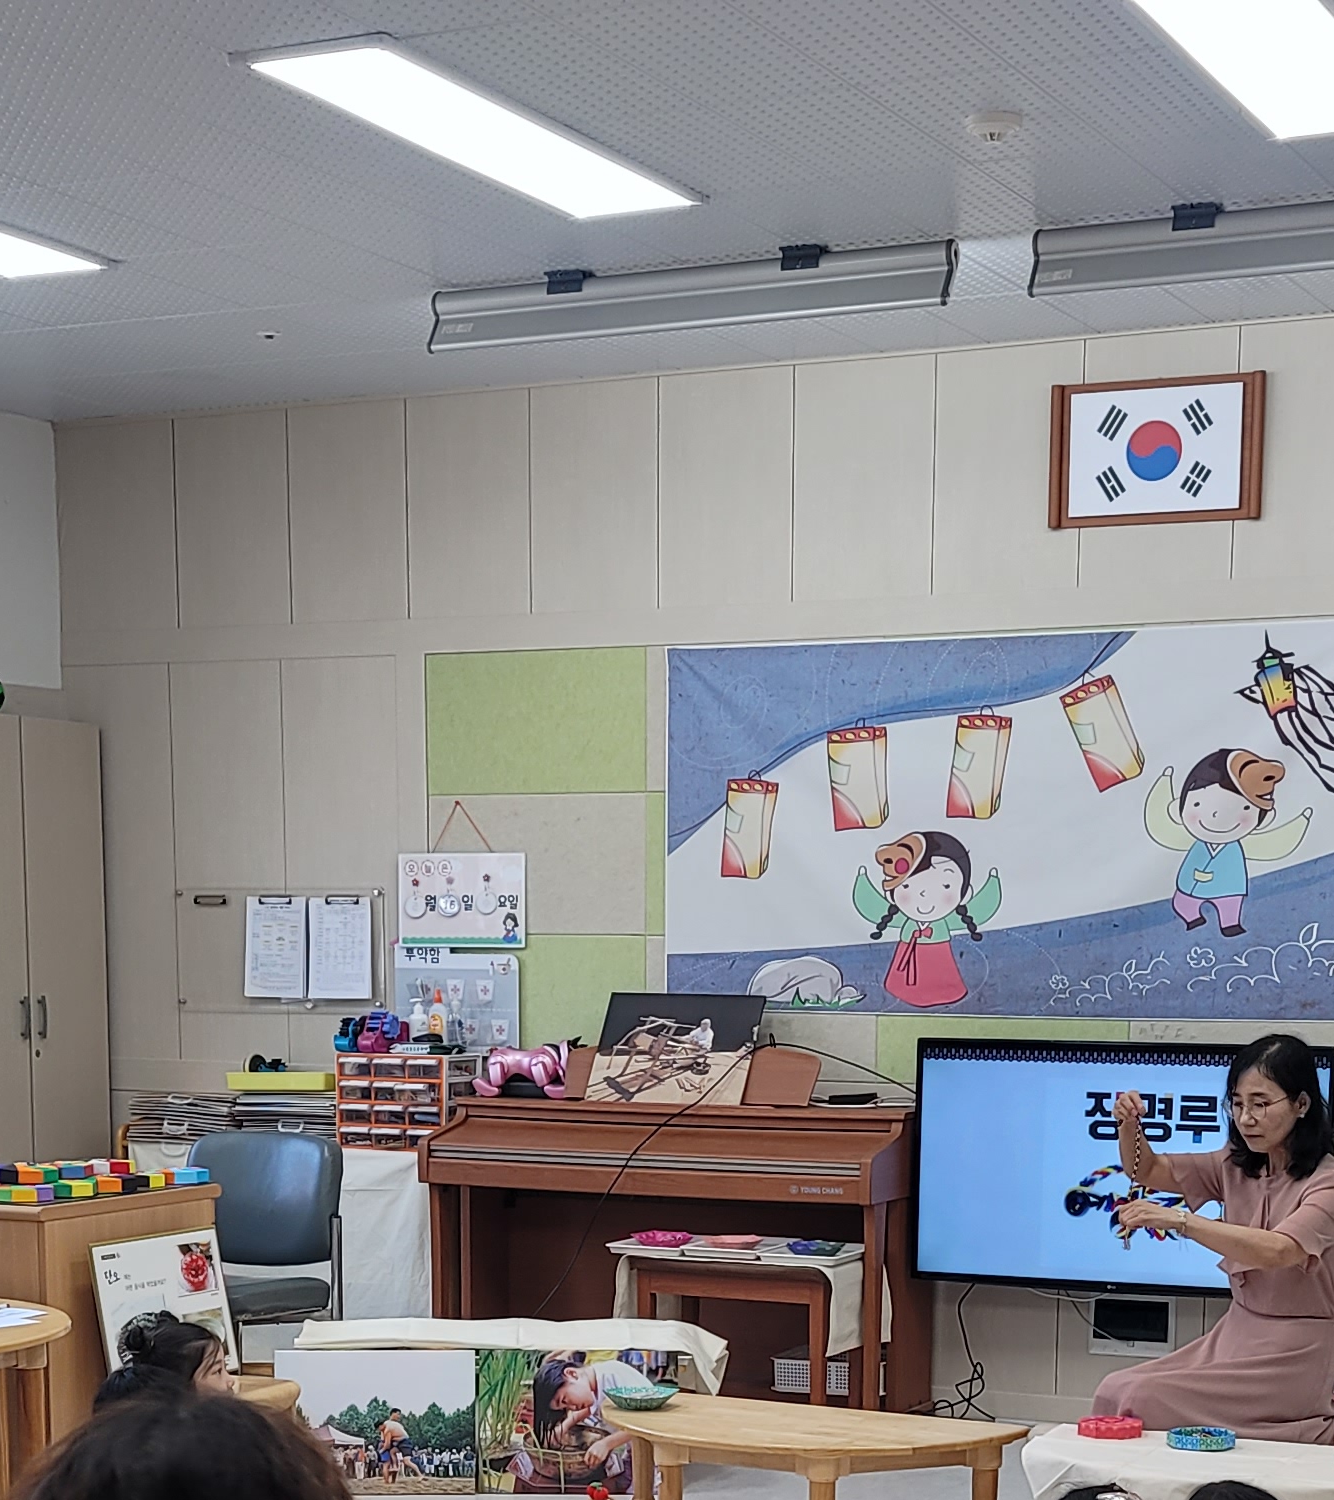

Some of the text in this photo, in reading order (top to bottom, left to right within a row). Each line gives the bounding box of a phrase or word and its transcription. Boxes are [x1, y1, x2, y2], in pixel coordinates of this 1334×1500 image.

[406, 861, 451, 876] 오늘은
[424, 894, 437, 912] 월
[461, 894, 474, 911] 일
[497, 894, 519, 910] 요일
